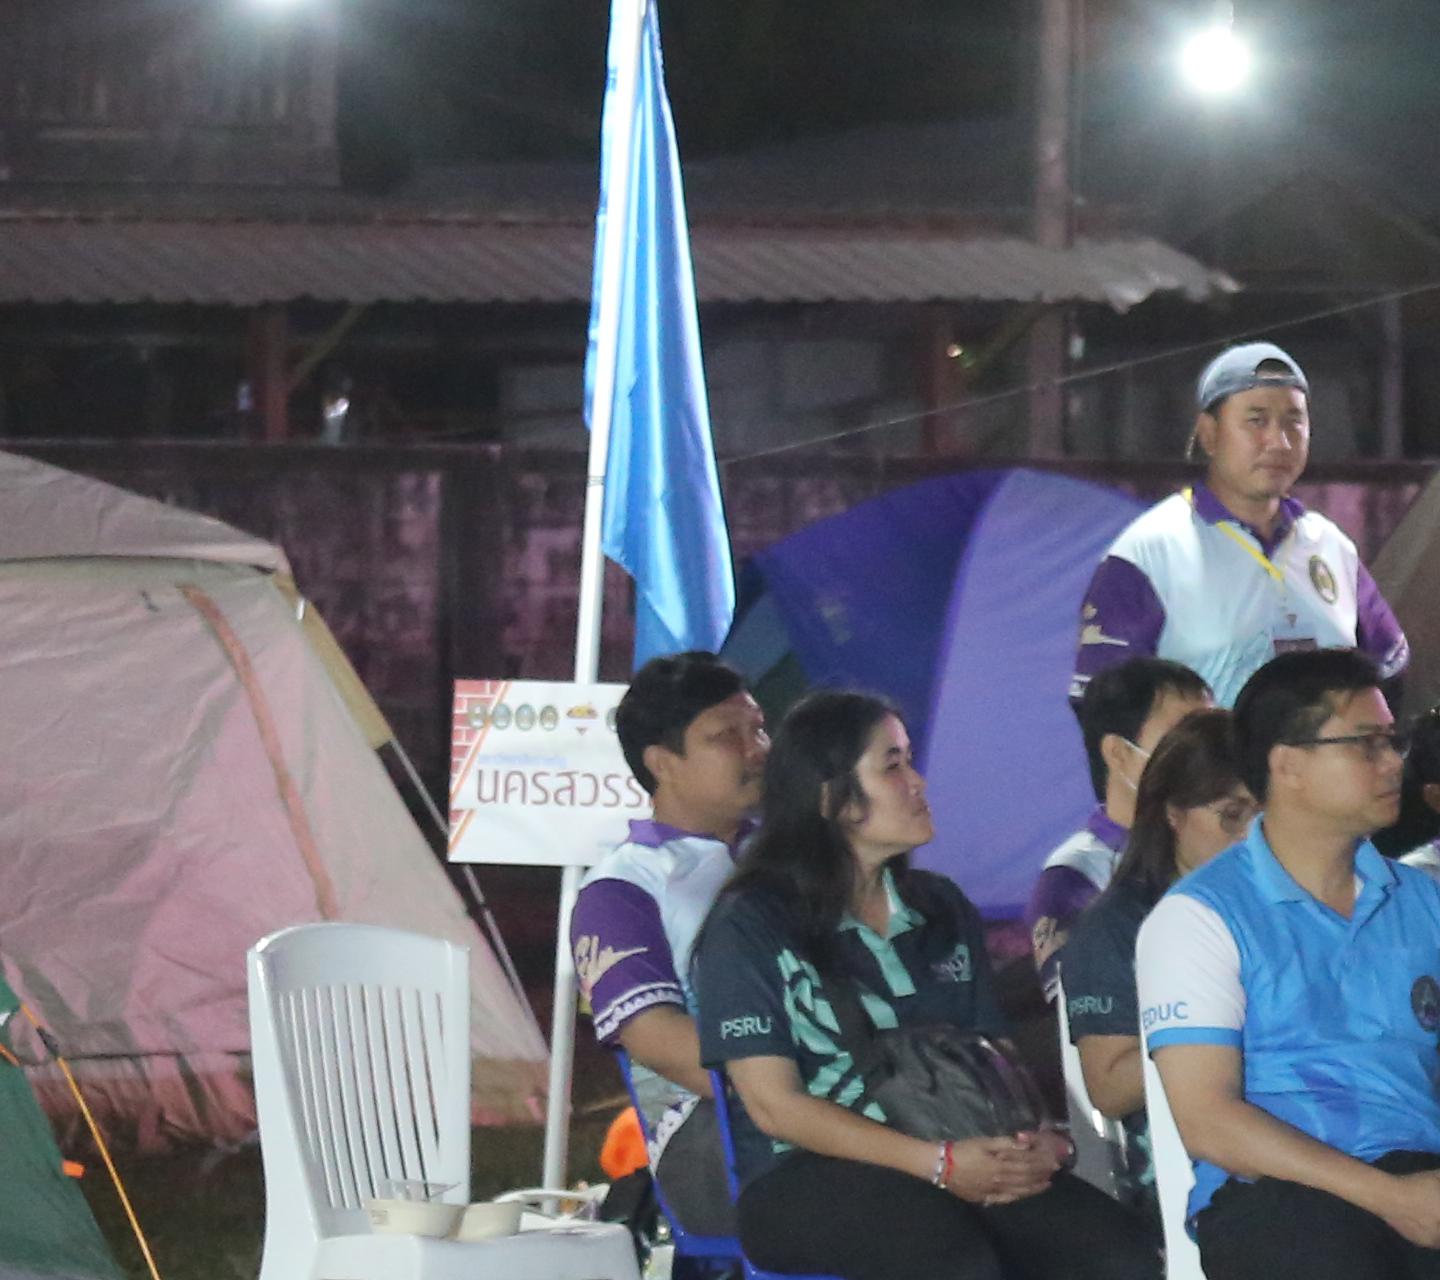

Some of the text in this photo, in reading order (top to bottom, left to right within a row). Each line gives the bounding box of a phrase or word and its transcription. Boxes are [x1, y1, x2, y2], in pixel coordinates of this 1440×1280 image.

[477, 769, 653, 809] นครสวรร
[721, 1016, 772, 1041] PSRU
